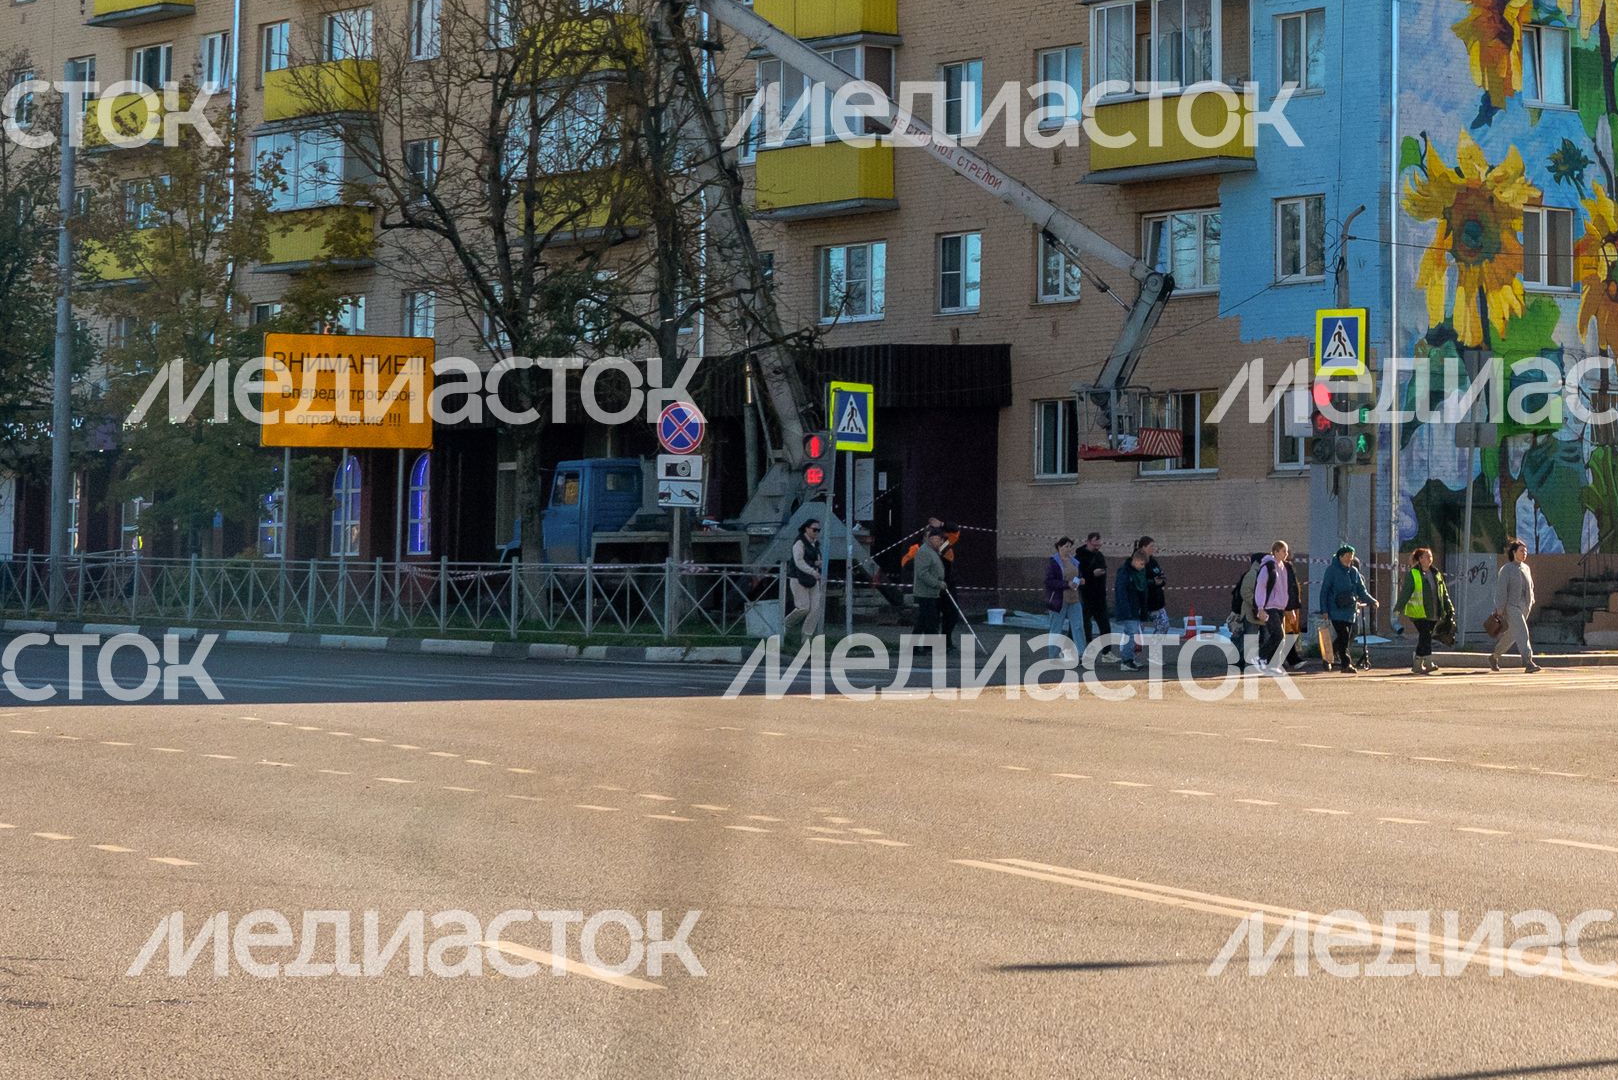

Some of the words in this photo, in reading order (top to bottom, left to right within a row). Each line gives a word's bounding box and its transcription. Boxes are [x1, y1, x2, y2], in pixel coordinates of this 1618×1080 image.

[956, 154, 1002, 190] СТРЕЛОЙ
[273, 351, 427, 376] ВНИМАНИЕ!!!
[281, 385, 345, 401] Впереди
